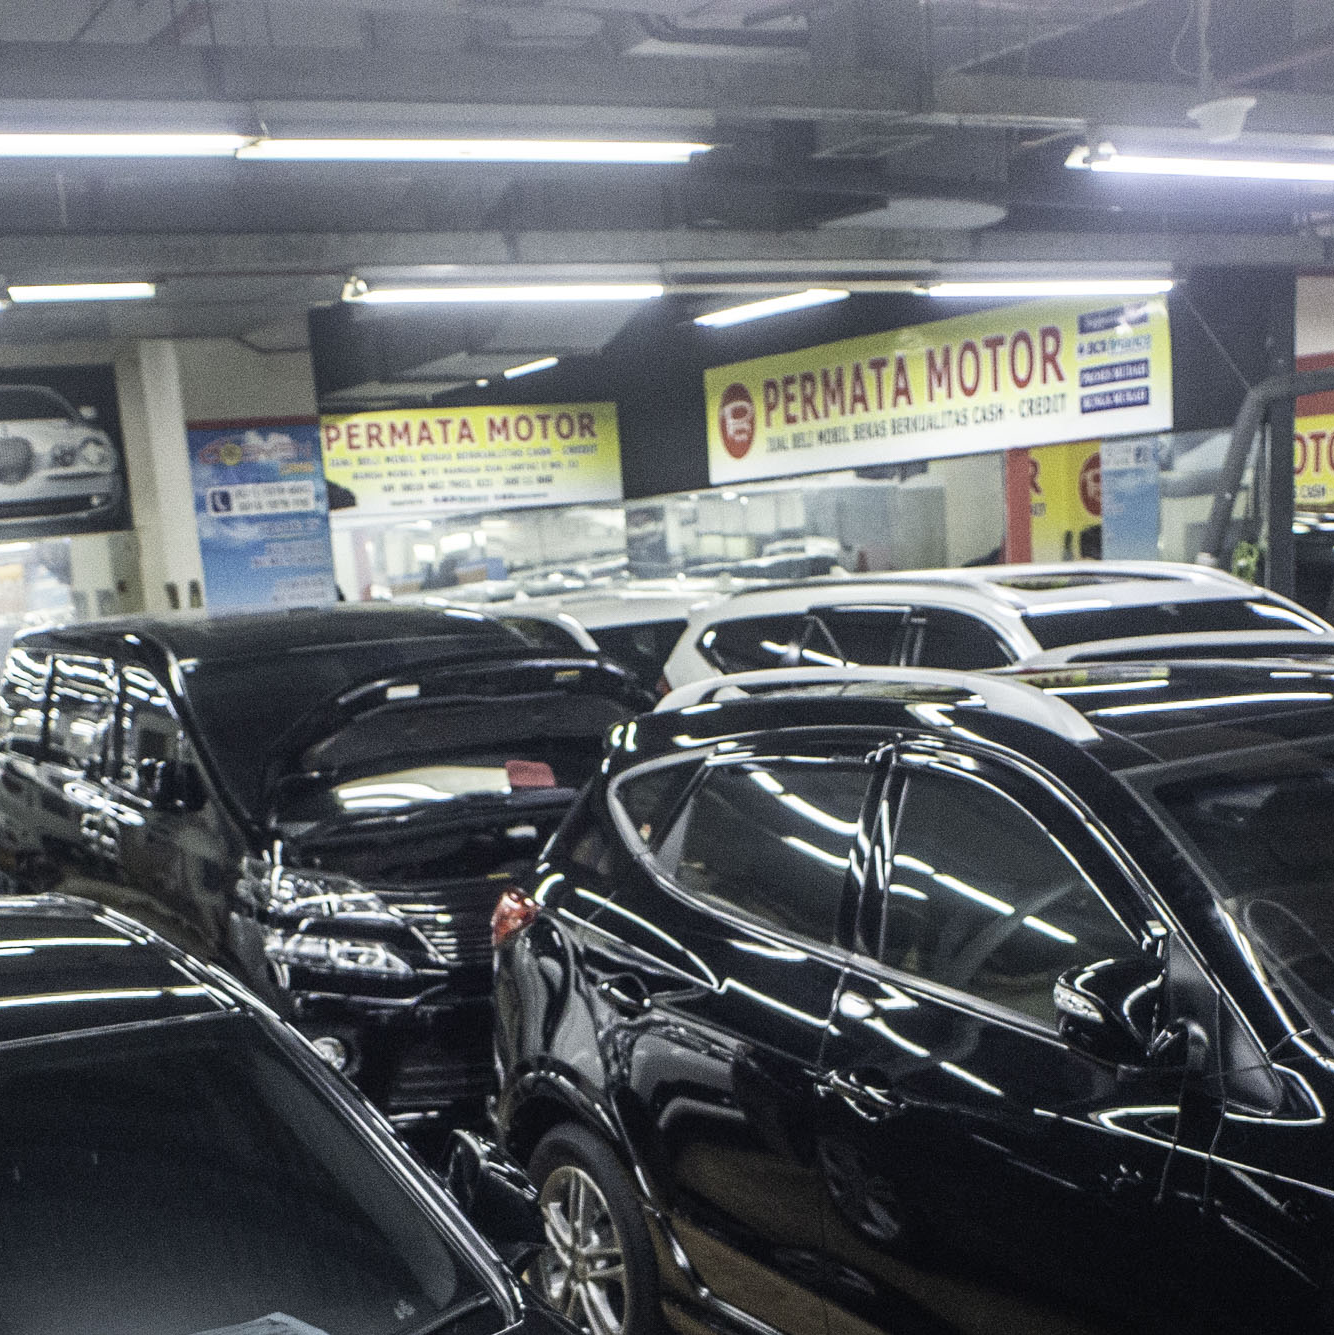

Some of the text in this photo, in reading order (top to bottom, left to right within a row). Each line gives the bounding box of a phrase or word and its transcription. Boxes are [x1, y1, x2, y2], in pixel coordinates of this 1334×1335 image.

[763, 325, 1066, 429] PERMATA MOTOR
[325, 411, 599, 452] PERMATA MOTOR
[853, 420, 888, 441] BEKAS
[891, 407, 968, 436] BERKUALITAS
[973, 402, 1005, 425] CASH
[1018, 392, 1067, 419] CREDIT
